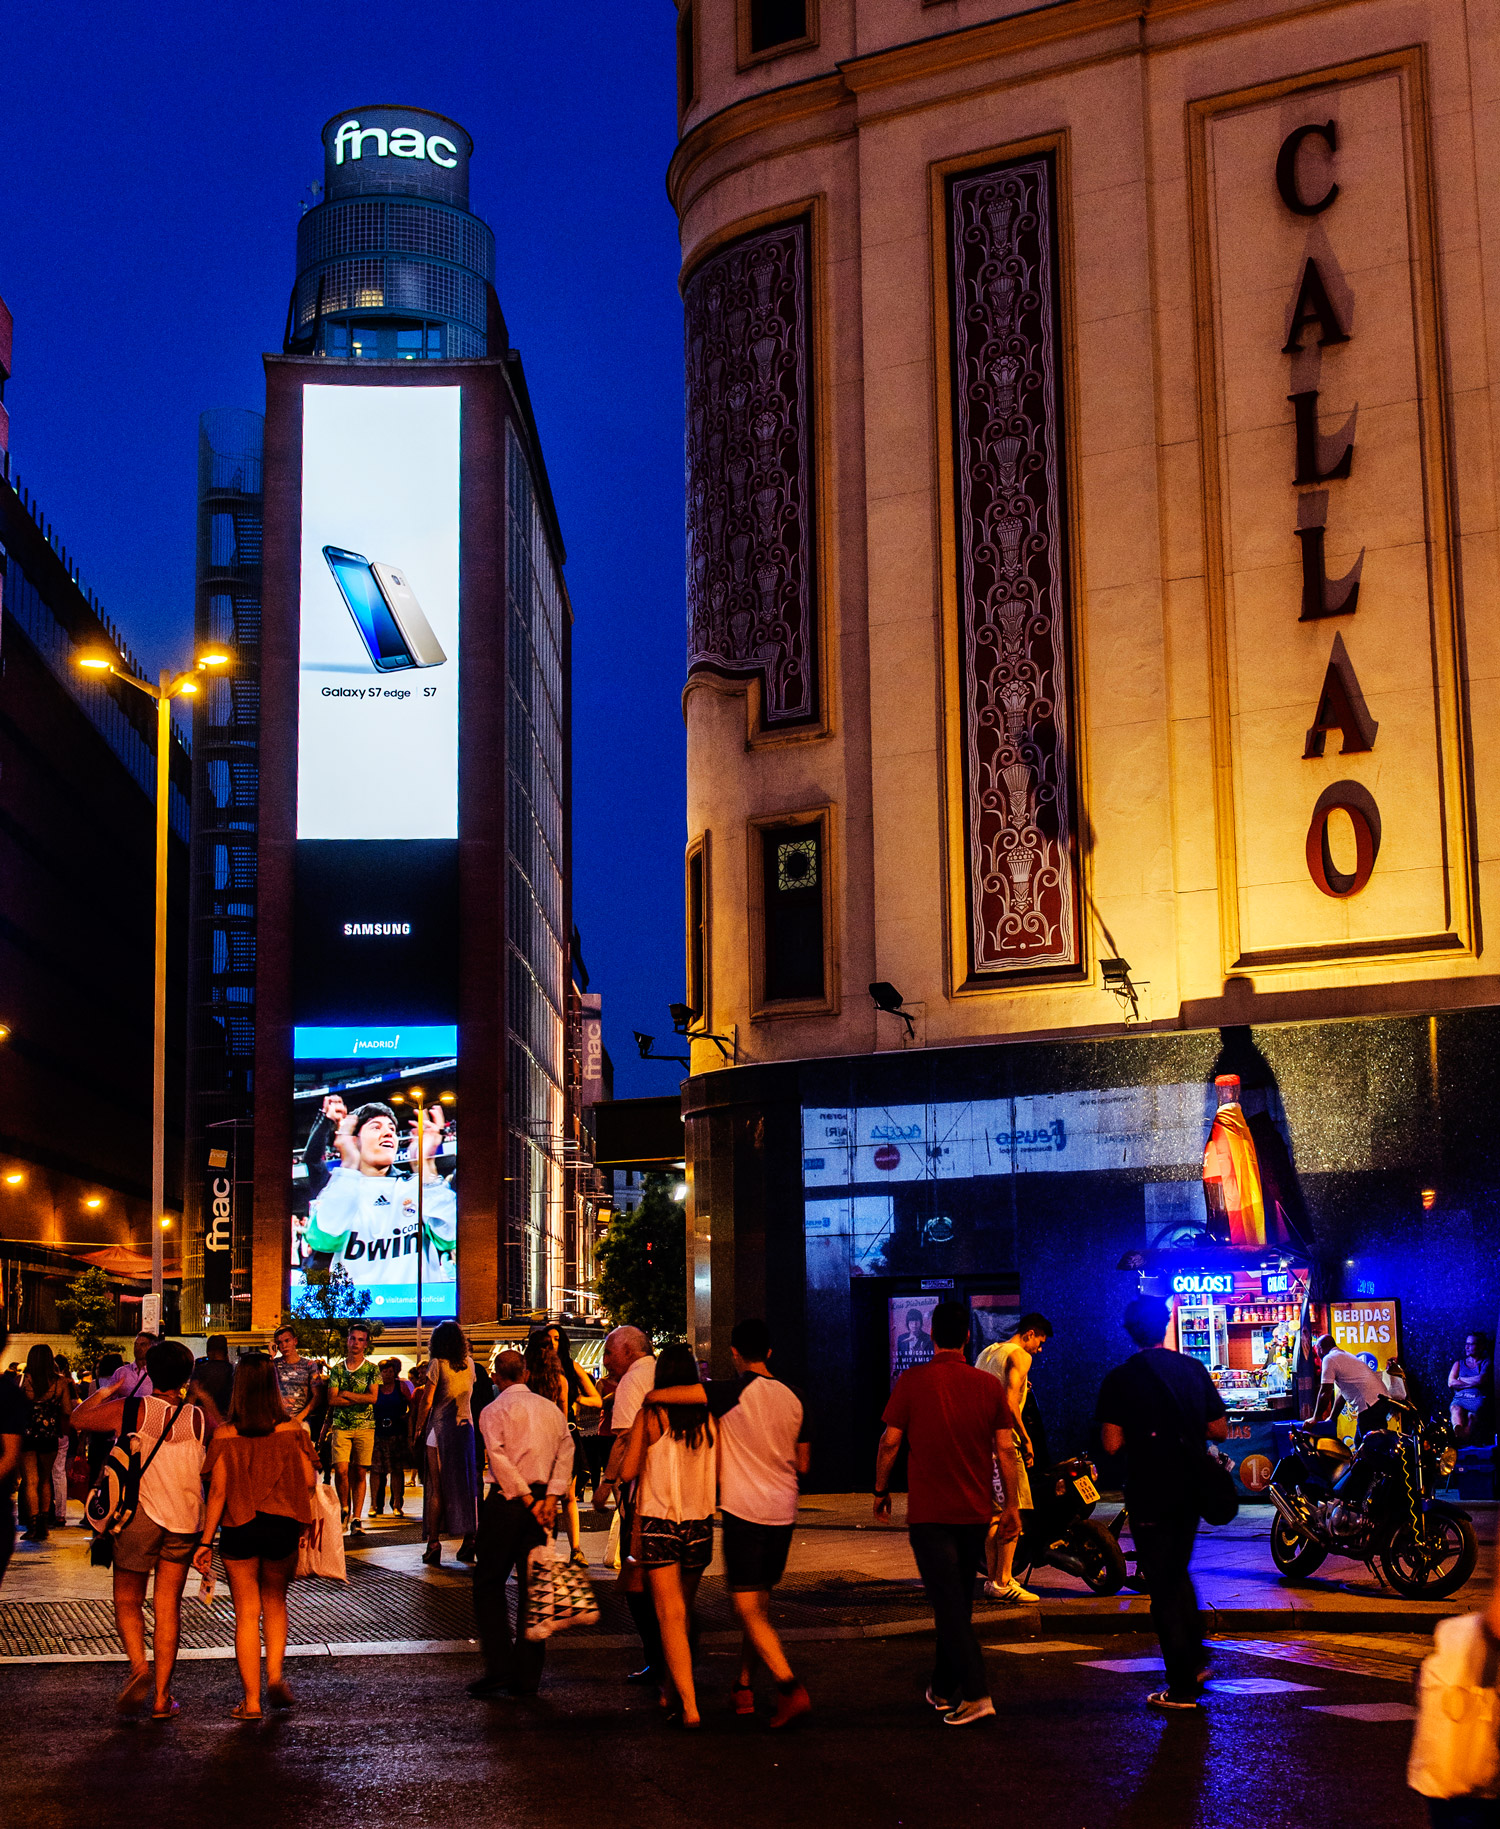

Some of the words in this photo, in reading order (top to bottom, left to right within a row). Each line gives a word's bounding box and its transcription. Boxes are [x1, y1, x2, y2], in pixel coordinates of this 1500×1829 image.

[334, 120, 458, 168] fnac
[1276, 119, 1375, 899] CALLAO
[321, 687, 366, 700] Galaxy
[368, 688, 382, 697] S7
[383, 690, 411, 700] edge
[423, 687, 437, 697] S7
[344, 923, 411, 935] SAMSUNG
[353, 1034, 400, 1054] ¡MADRID!
[585, 1023, 601, 1080] fnac
[205, 1178, 231, 1252] fnac
[344, 1228, 420, 1262] bwin
[1173, 1275, 1232, 1293] GOLOSI
[1267, 1275, 1288, 1293] GOLOSI
[386, 1296, 445, 1304] visitamaddoficial
[1334, 1308, 1391, 1323] BEBIDAS
[1335, 1322, 1391, 1344] FRÍAS
